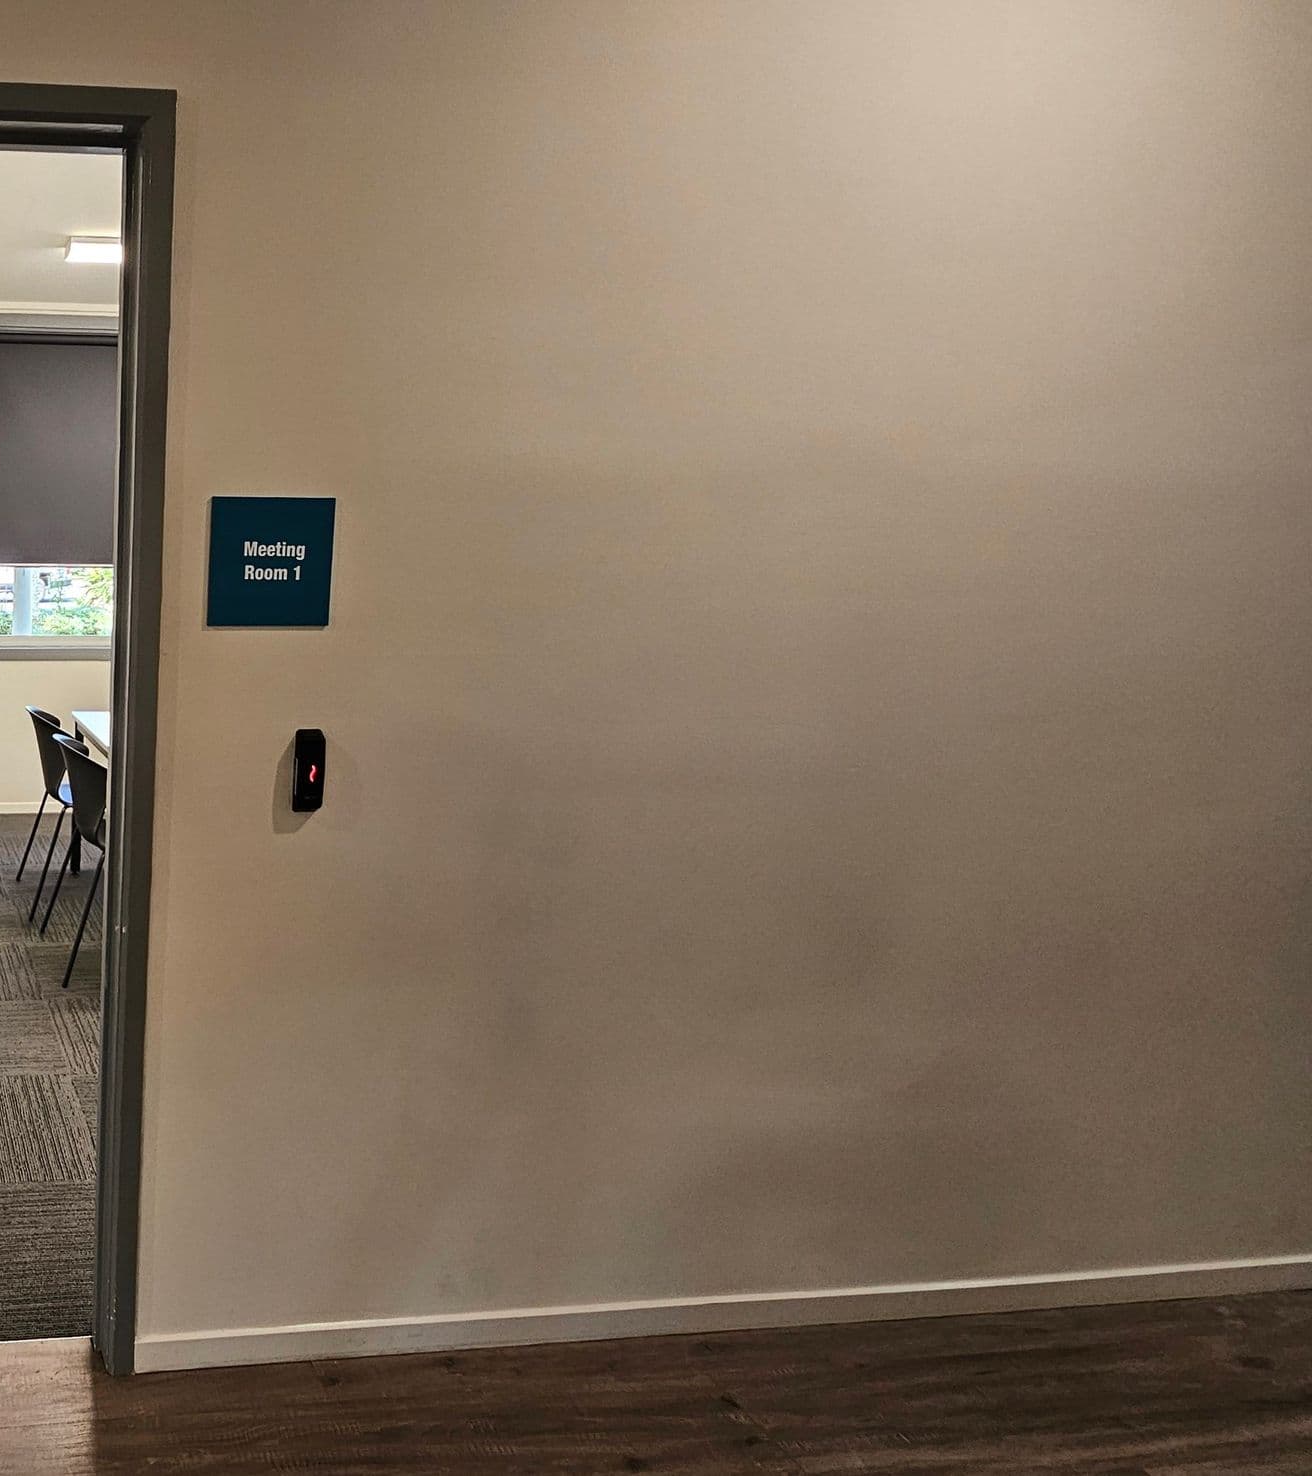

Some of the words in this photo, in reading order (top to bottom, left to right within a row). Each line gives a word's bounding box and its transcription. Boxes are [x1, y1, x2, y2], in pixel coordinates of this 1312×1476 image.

[244, 541, 306, 560] Meeting
[244, 564, 288, 580] Room
[294, 565, 301, 580] 1
